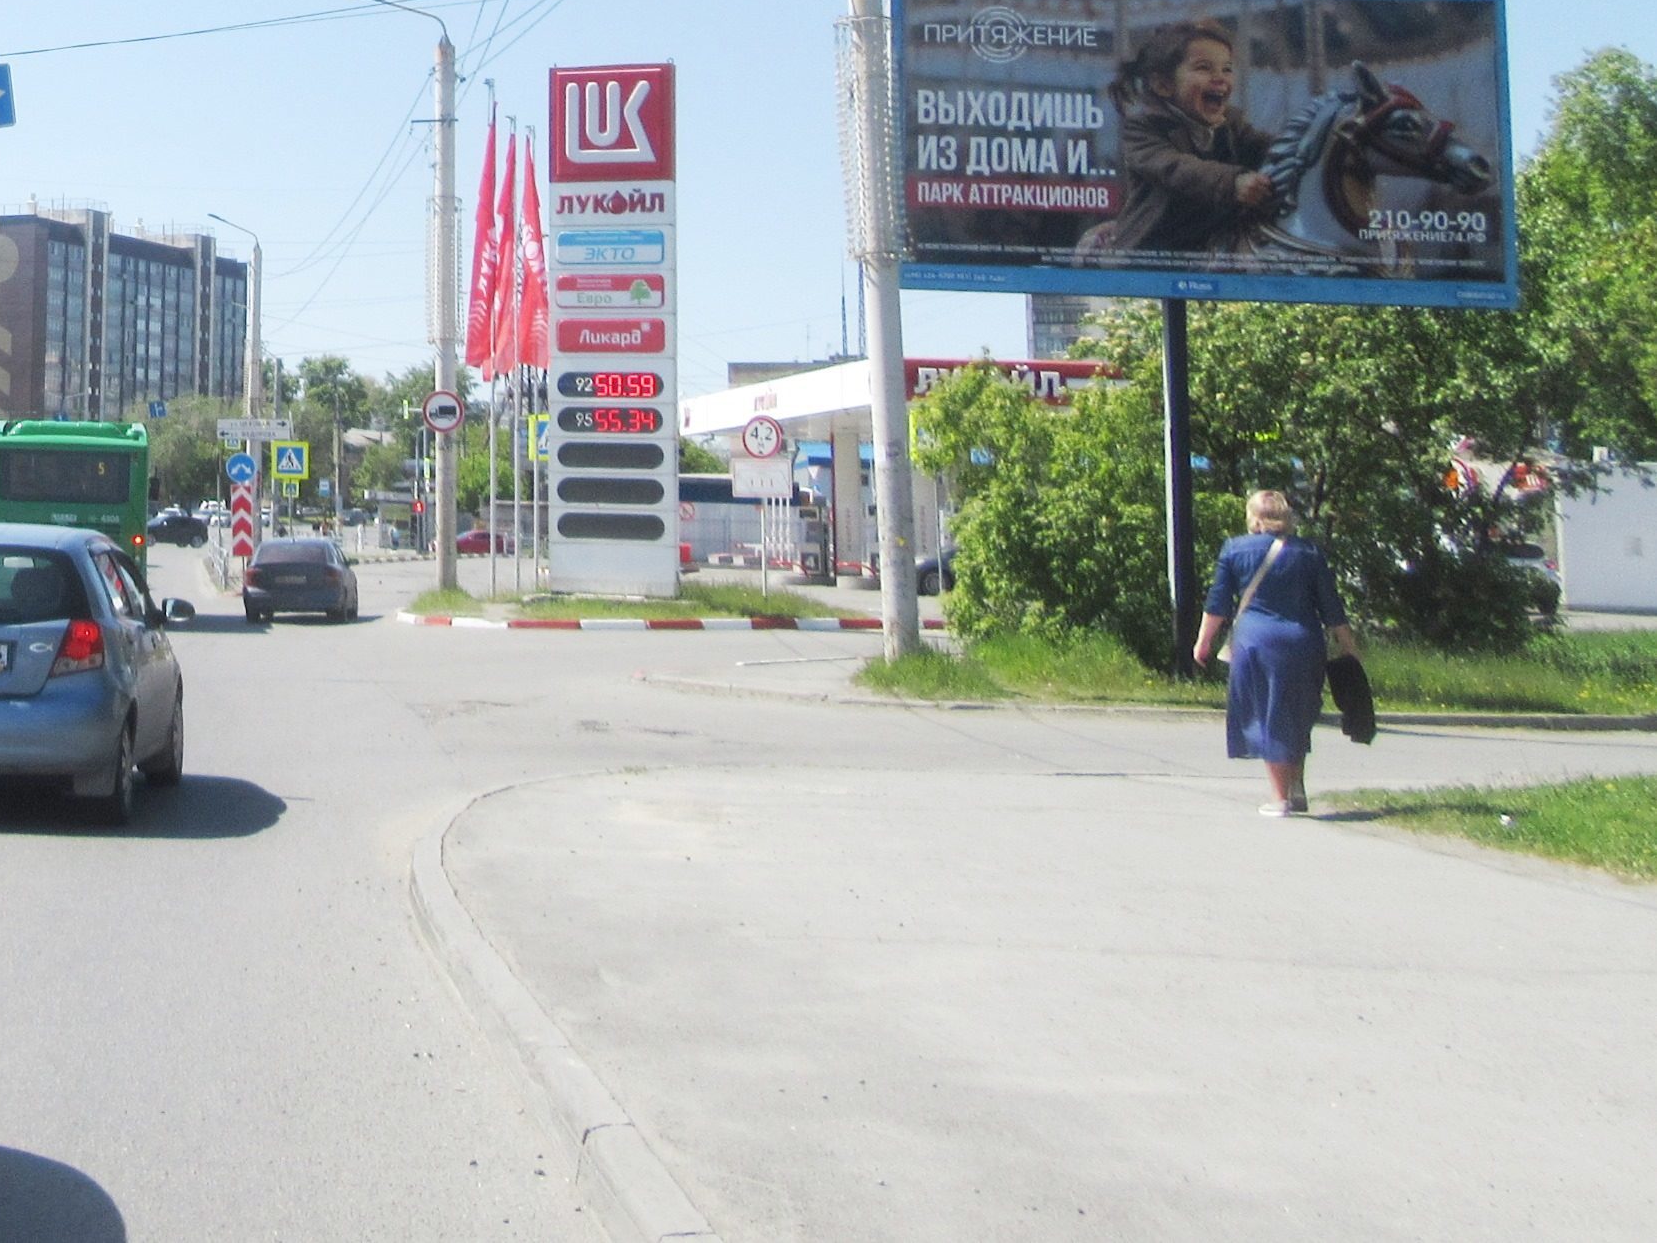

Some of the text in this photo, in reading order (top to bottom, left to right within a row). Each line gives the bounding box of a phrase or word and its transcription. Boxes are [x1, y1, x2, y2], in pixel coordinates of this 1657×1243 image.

[924, 23, 1098, 47] ПРИТЯЖЕНИЕ
[917, 89, 1105, 131] ВЫХОДИШЬ
[917, 134, 1117, 177] ИЗ ДОМА И...
[917, 181, 1110, 209] ПАРК АТТРАКЦИОНОВ
[1368, 209, 1487, 232] 210-90-90
[584, 246, 636, 261] ЭКТО
[579, 329, 642, 348] Ликард
[575, 373, 655, 397] 92 50.59
[575, 408, 655, 432] 95 55.34
